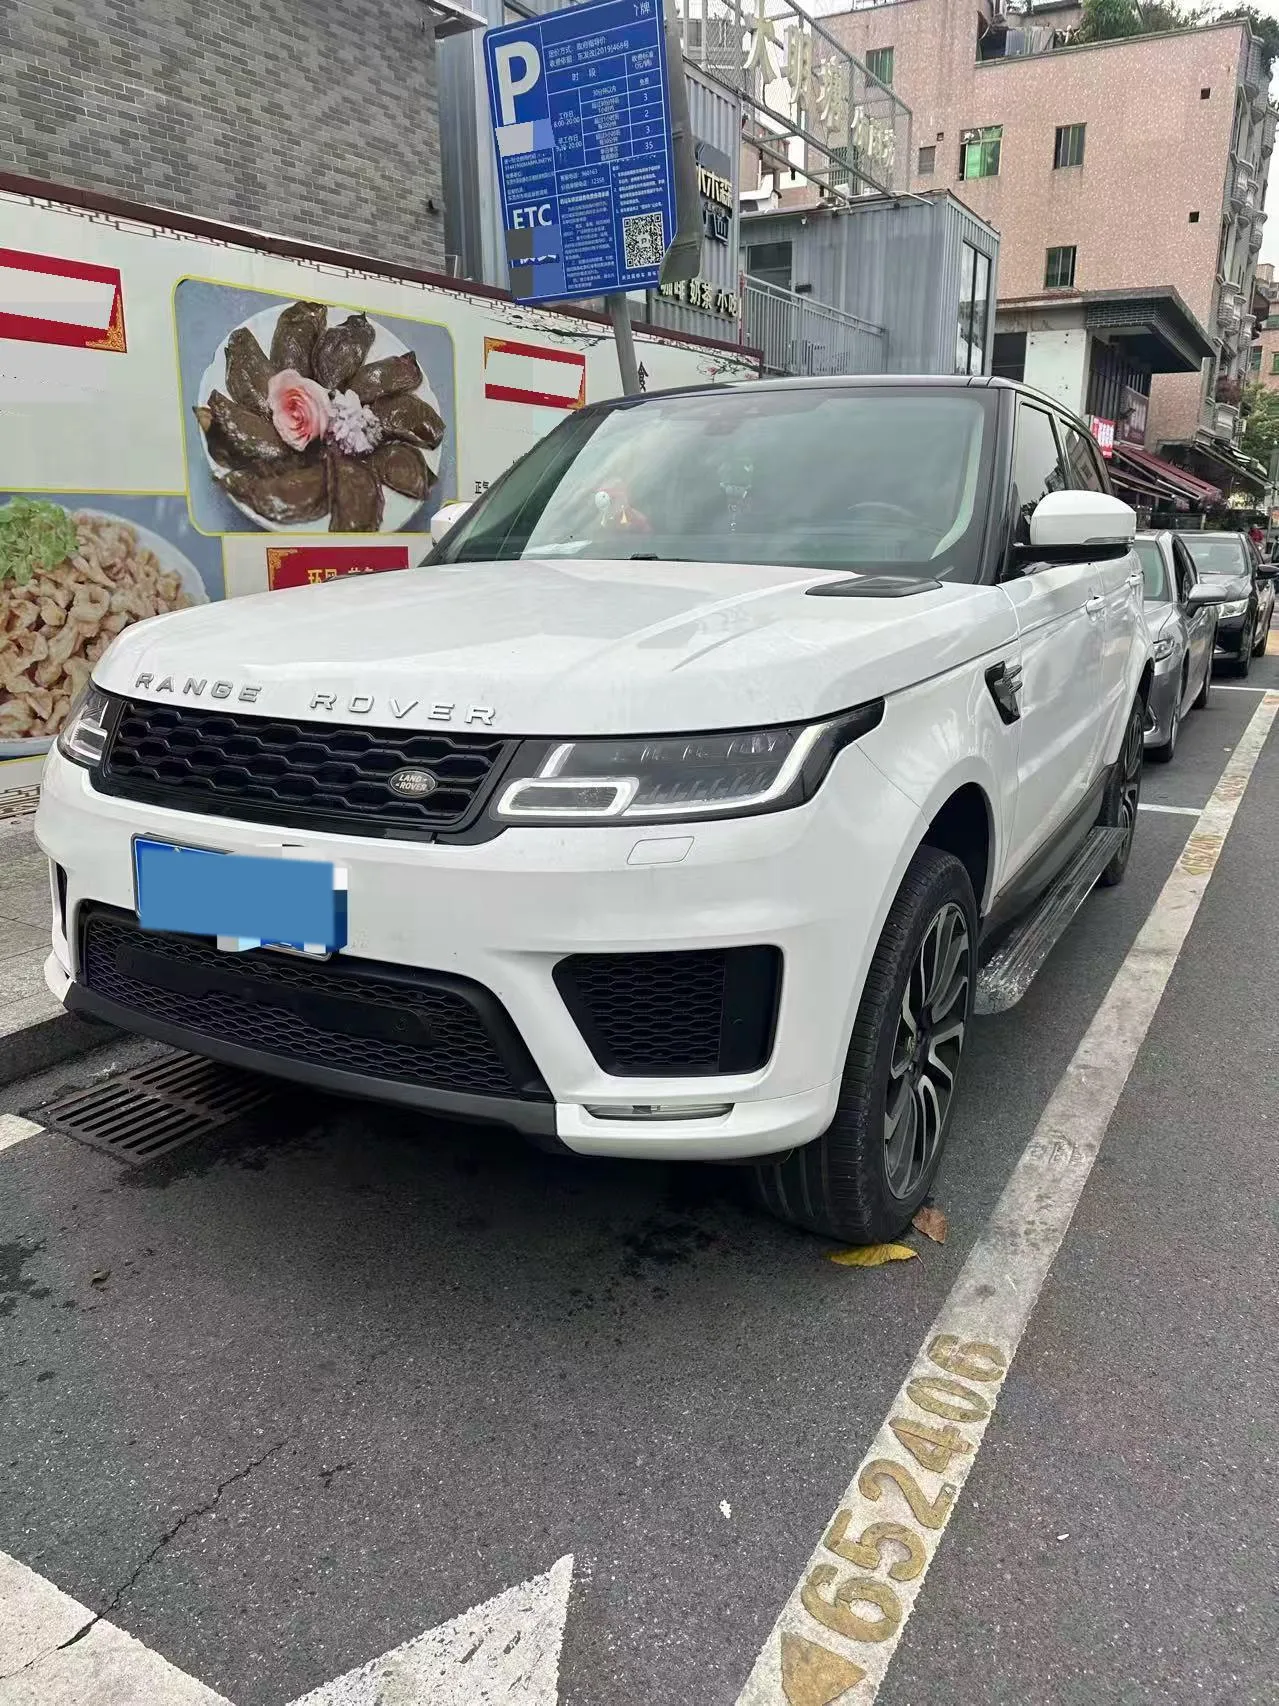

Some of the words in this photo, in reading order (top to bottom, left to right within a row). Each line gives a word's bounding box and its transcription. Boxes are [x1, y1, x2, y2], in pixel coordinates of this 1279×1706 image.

[494, 40, 541, 126] P
[643, 92, 649, 102] 3
[643, 109, 650, 118] 2
[645, 125, 651, 134] 3
[644, 142, 654, 150] 35
[512, 203, 554, 230] ETC
[690, 278, 713, 310] 奶茶
[134, 672, 263, 703] RANGE
[309, 691, 498, 726] ROVER
[800, 1334, 1007, 1643] 652406
